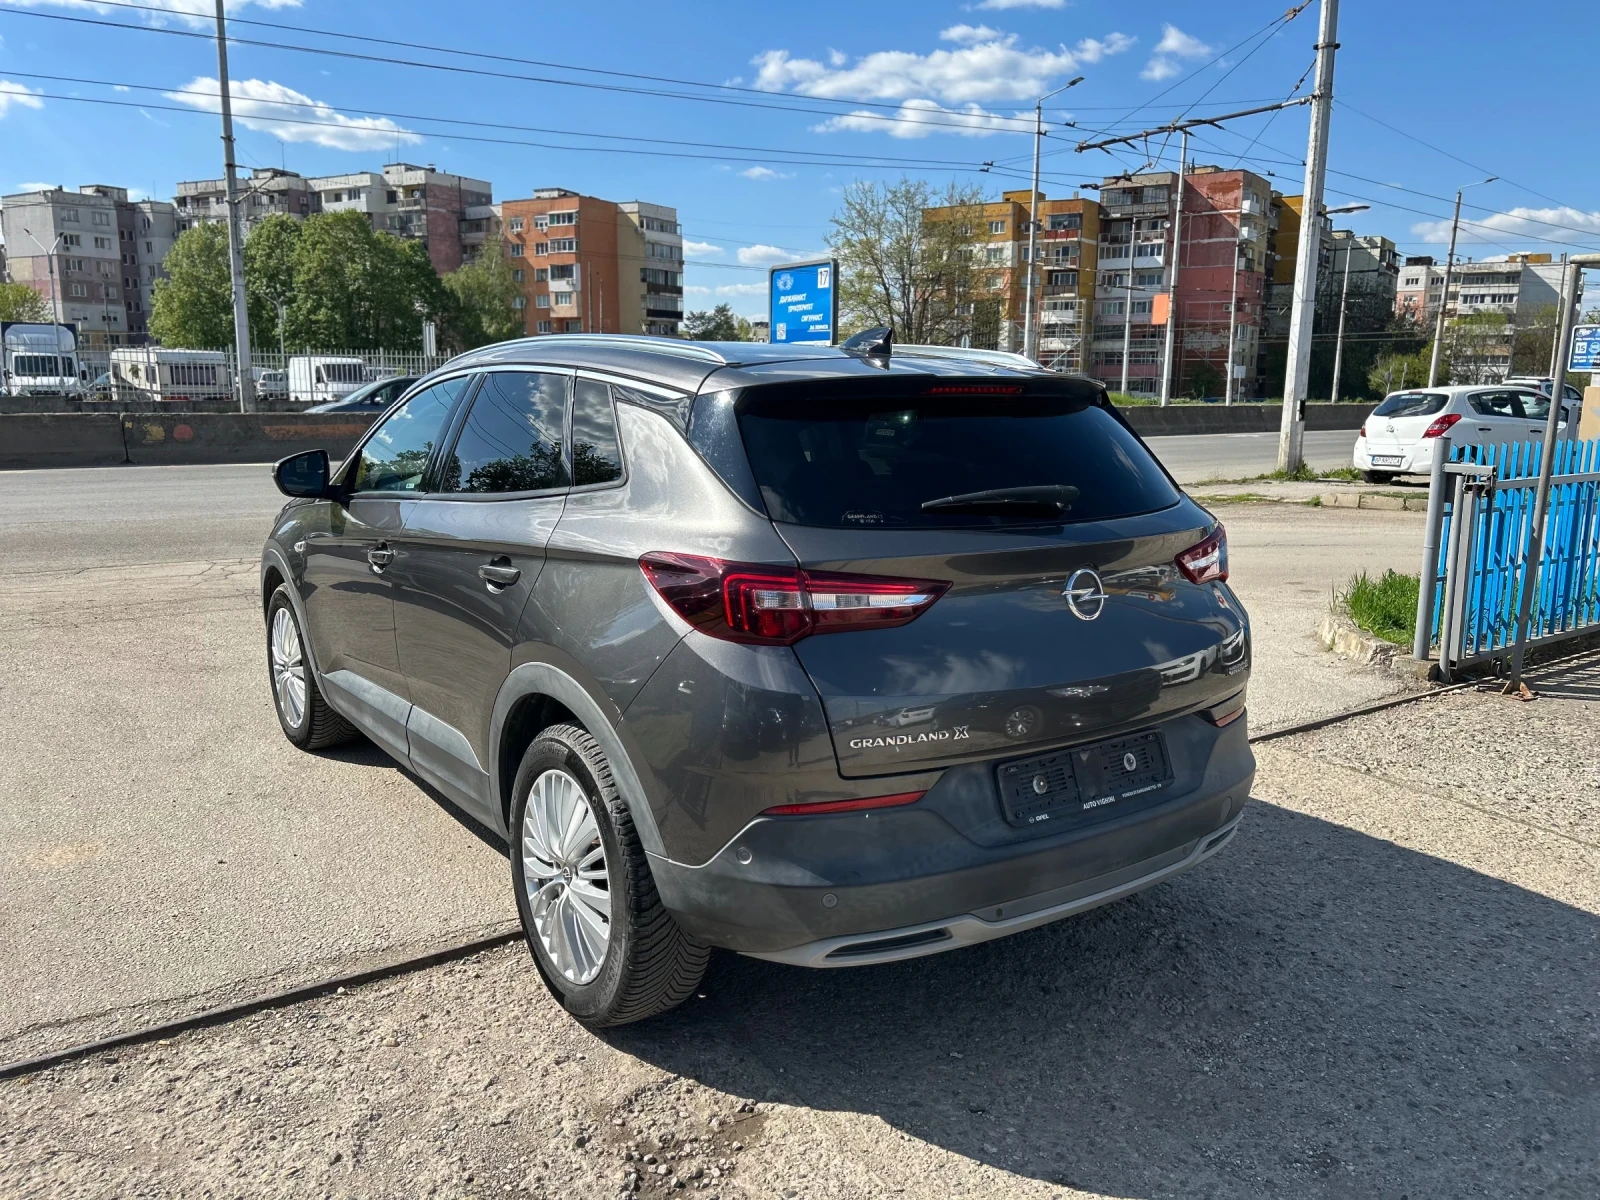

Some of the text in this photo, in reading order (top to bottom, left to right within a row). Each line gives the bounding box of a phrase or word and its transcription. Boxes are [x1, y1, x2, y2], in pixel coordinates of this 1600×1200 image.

[819, 270, 828, 286] 17
[850, 725, 969, 748] GRANDLAND X
[1036, 814, 1049, 822] OPEL
[1083, 799, 1097, 810] AUTO
